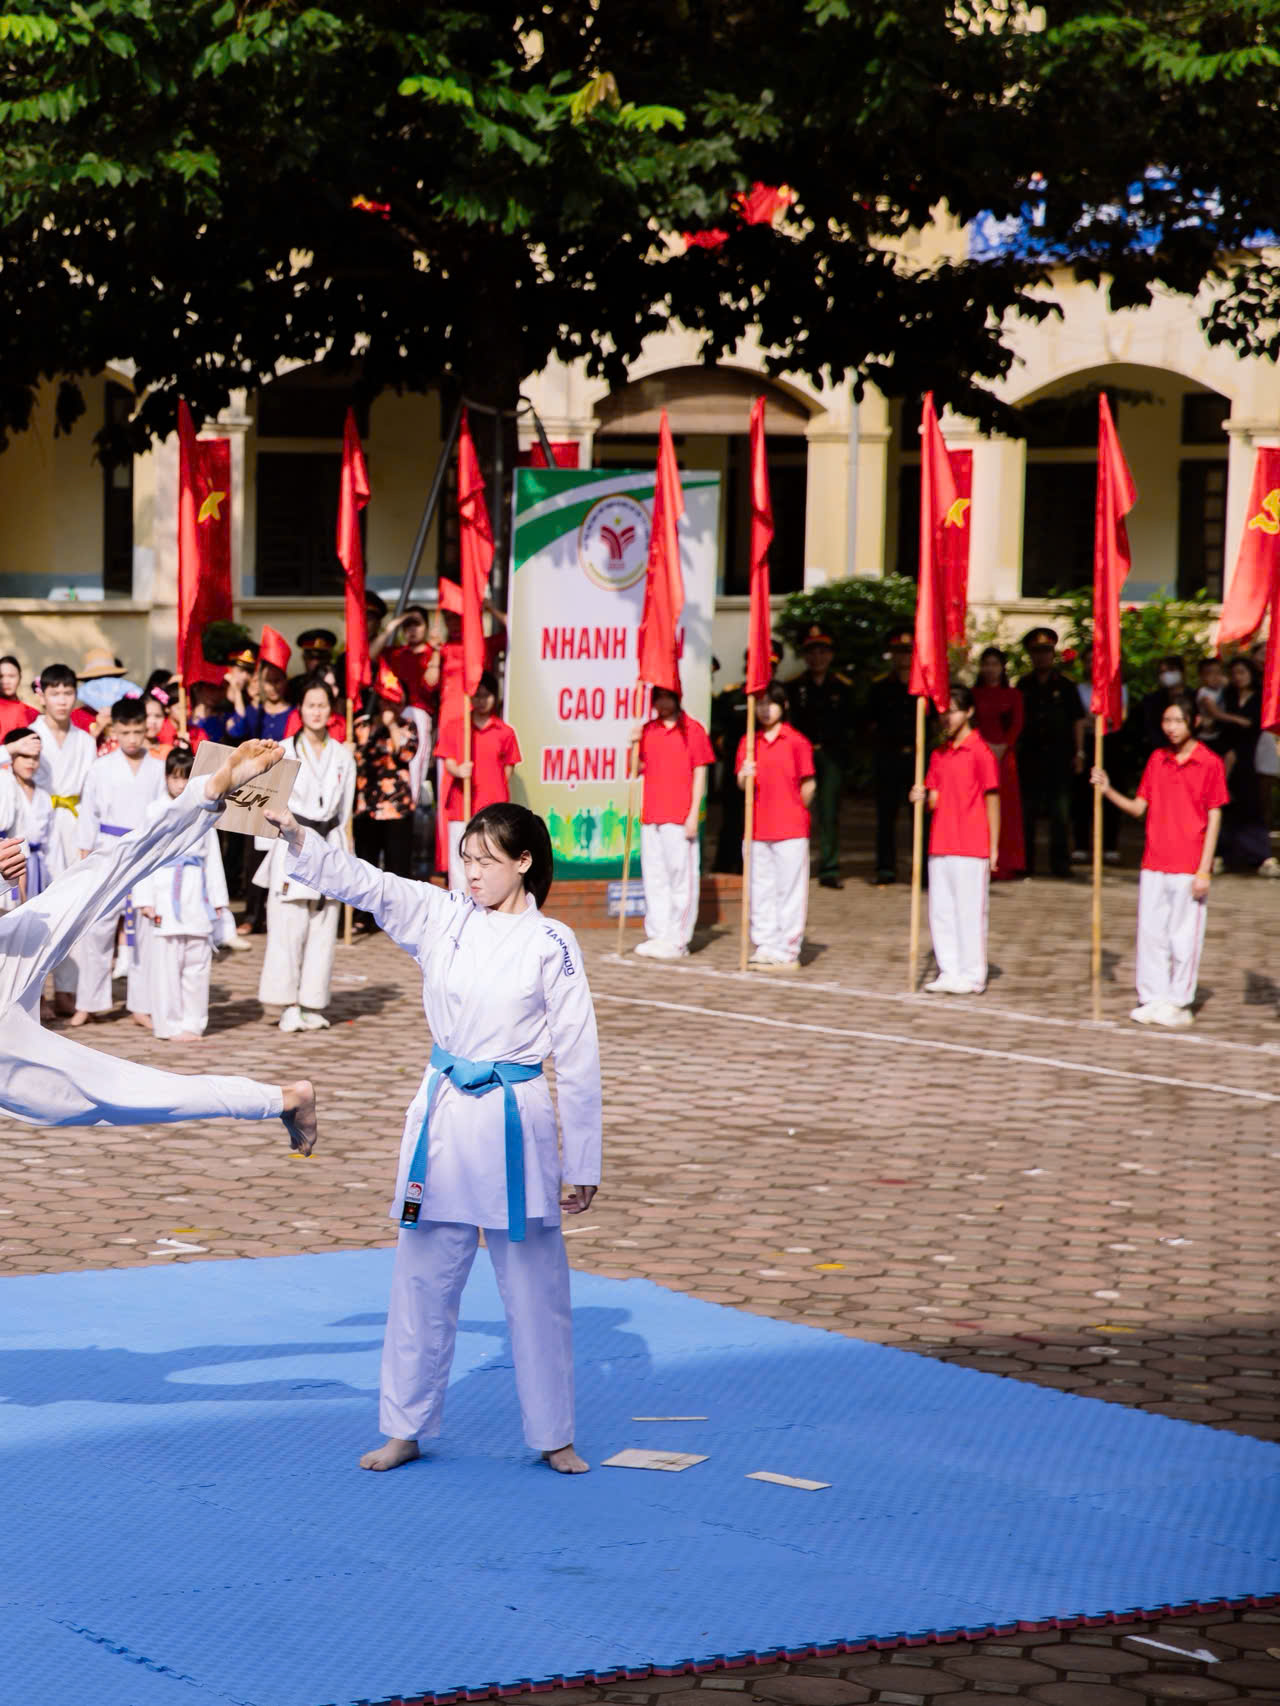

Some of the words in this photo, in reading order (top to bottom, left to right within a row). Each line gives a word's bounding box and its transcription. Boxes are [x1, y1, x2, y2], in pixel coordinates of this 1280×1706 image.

[541, 627, 626, 660] NHANH
[558, 687, 605, 720] CAO
[542, 747, 616, 789] MẠNH
